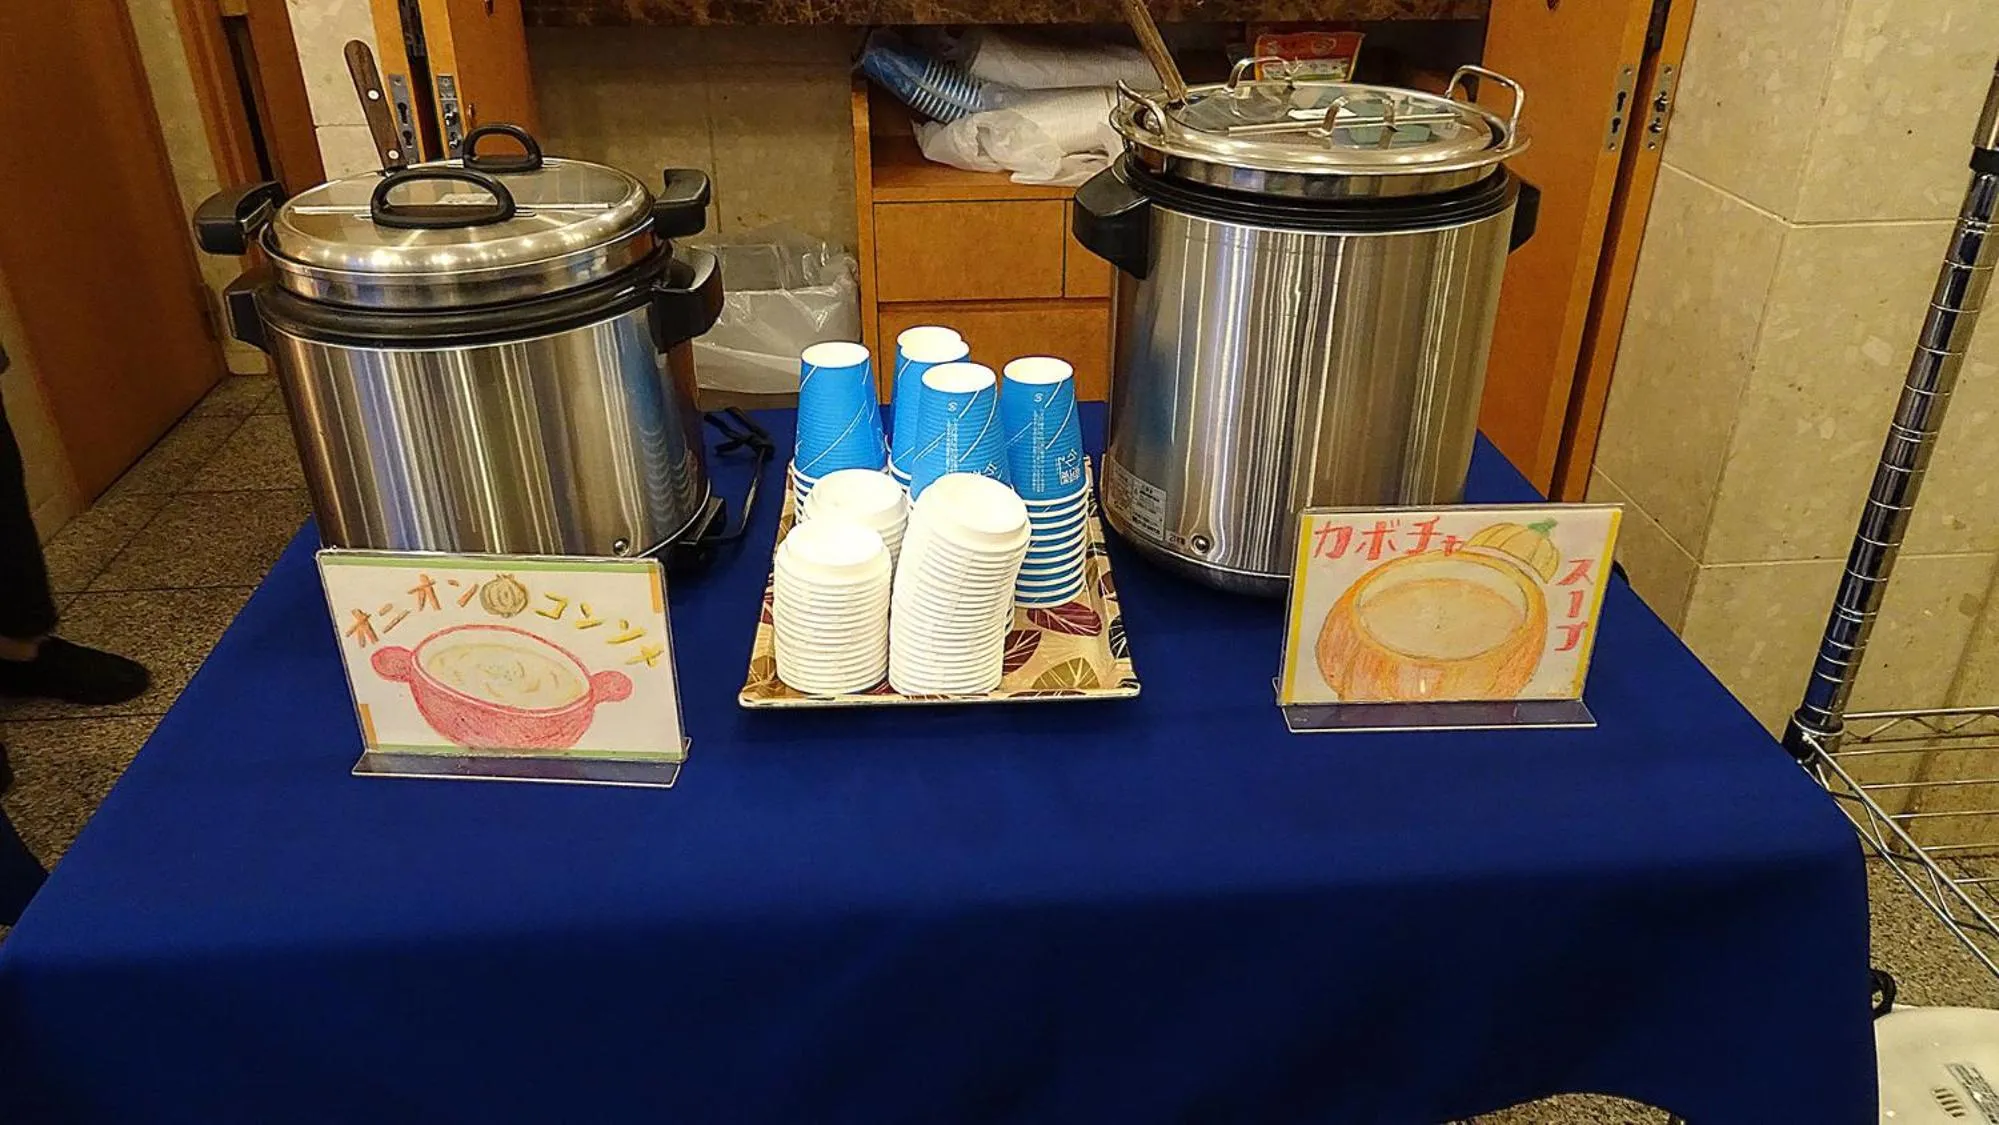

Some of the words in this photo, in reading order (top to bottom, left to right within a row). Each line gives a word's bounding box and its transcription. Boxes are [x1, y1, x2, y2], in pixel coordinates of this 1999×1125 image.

[1313, 517, 1463, 560] カボチャ
[345, 574, 480, 647] オニオン
[1554, 559, 1590, 651] スープ
